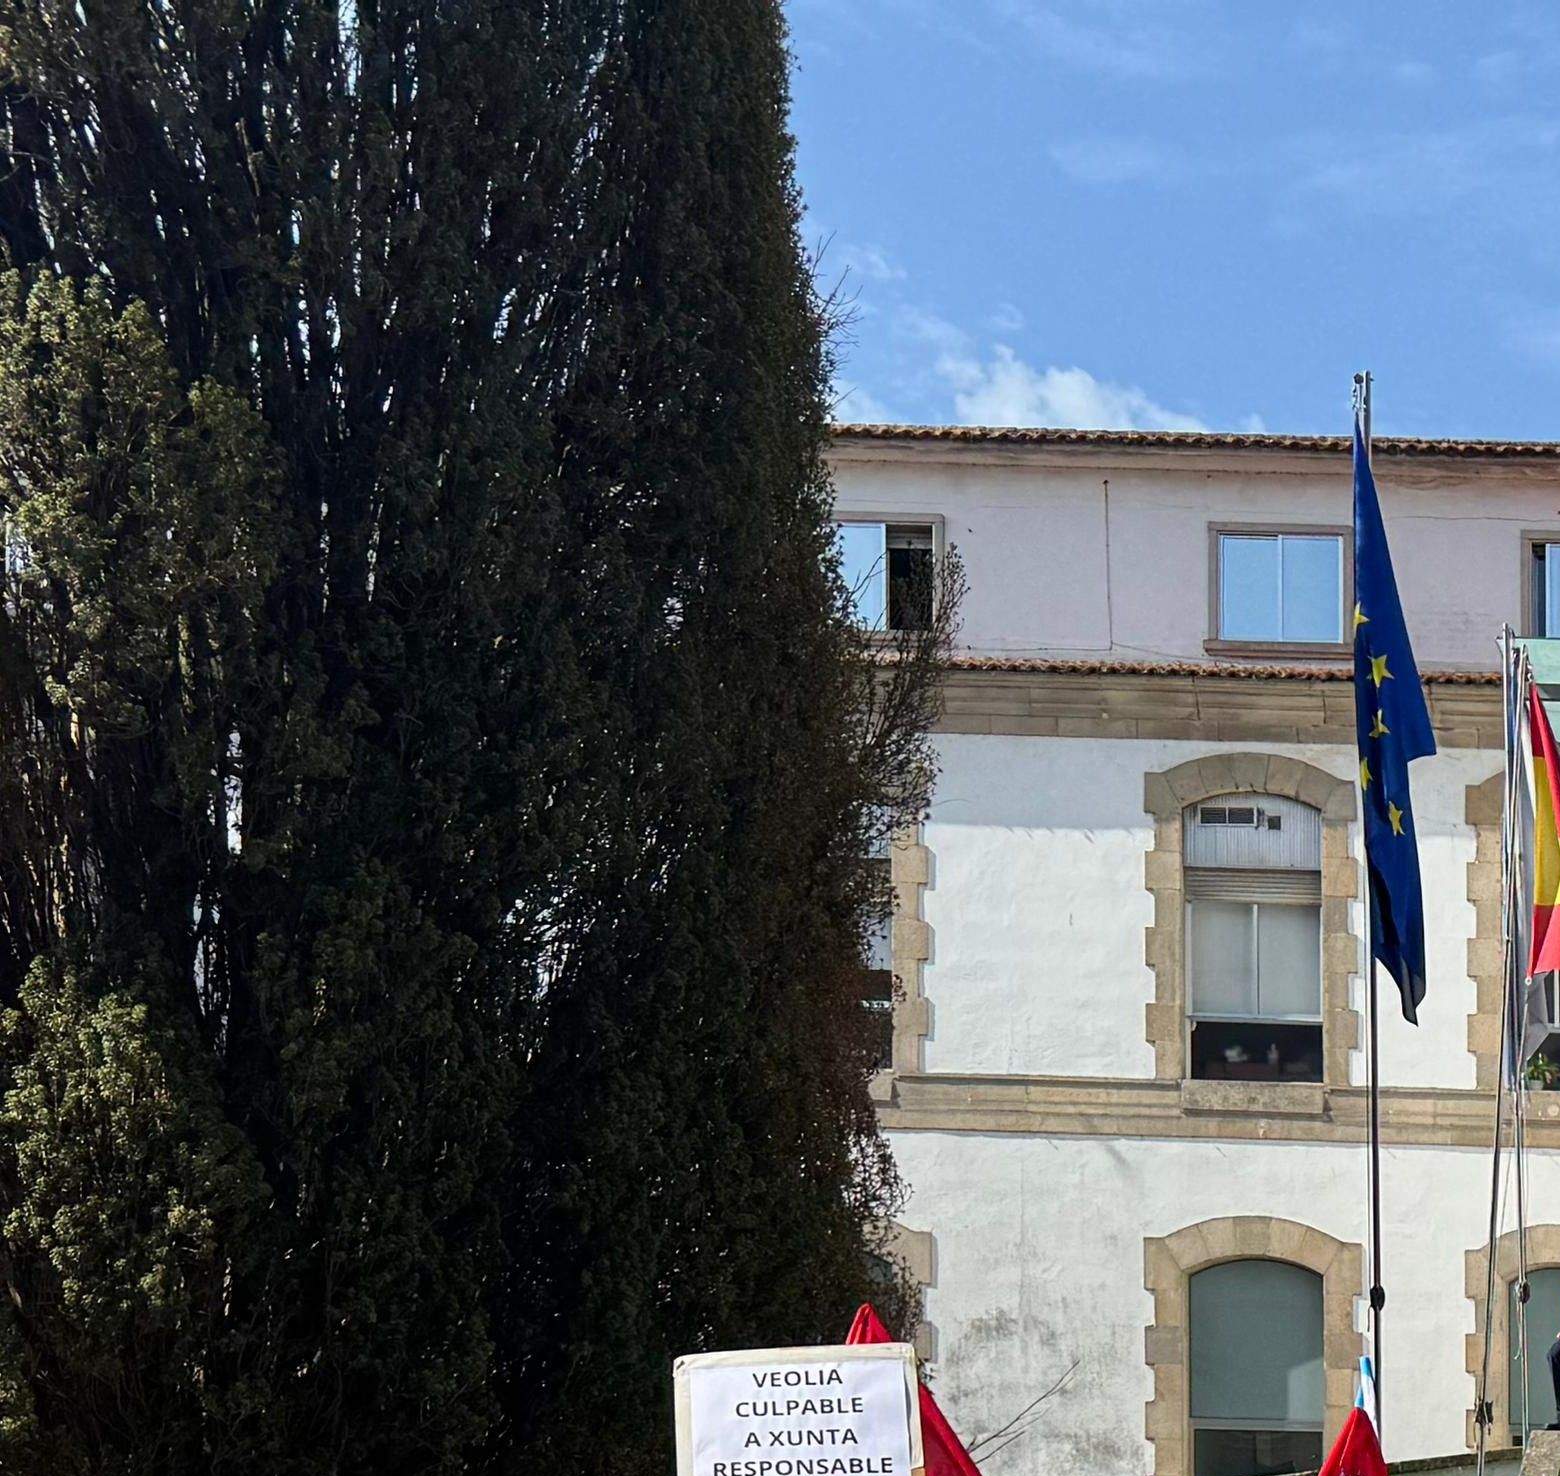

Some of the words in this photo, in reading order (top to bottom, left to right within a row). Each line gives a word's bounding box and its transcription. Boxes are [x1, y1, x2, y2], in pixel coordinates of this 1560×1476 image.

[752, 1369, 843, 1388] VEOLIA
[735, 1397, 863, 1418] CULPABLE
[744, 1432, 761, 1448] A
[769, 1428, 858, 1447] XUNTA
